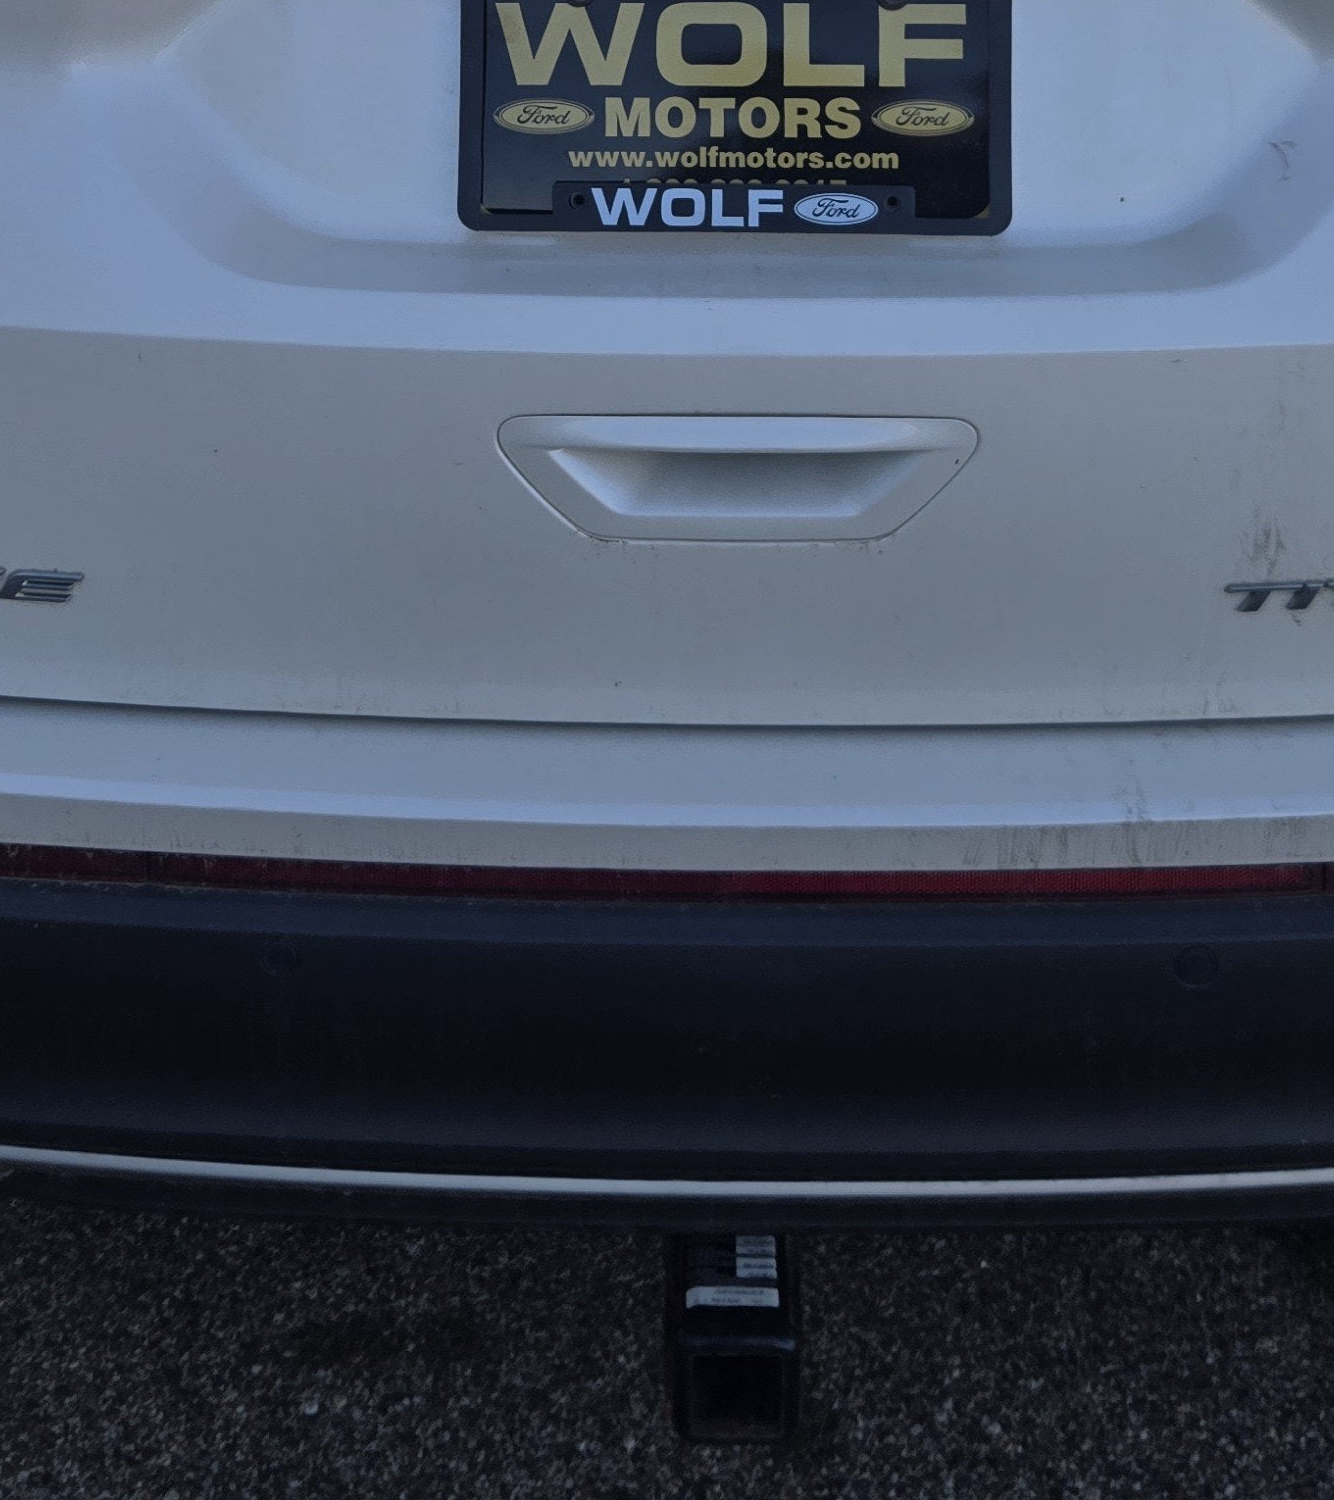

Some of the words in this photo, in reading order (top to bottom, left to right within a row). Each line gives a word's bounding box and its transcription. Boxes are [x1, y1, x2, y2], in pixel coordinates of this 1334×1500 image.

[496, 1, 967, 87] WOLF
[517, 106, 571, 128] Ford
[605, 96, 862, 139] MOTORS
[895, 106, 950, 129] Ford
[568, 146, 899, 171] www.wolfmotors.com
[591, 188, 784, 228] WOLF
[812, 197, 861, 218] Ford
